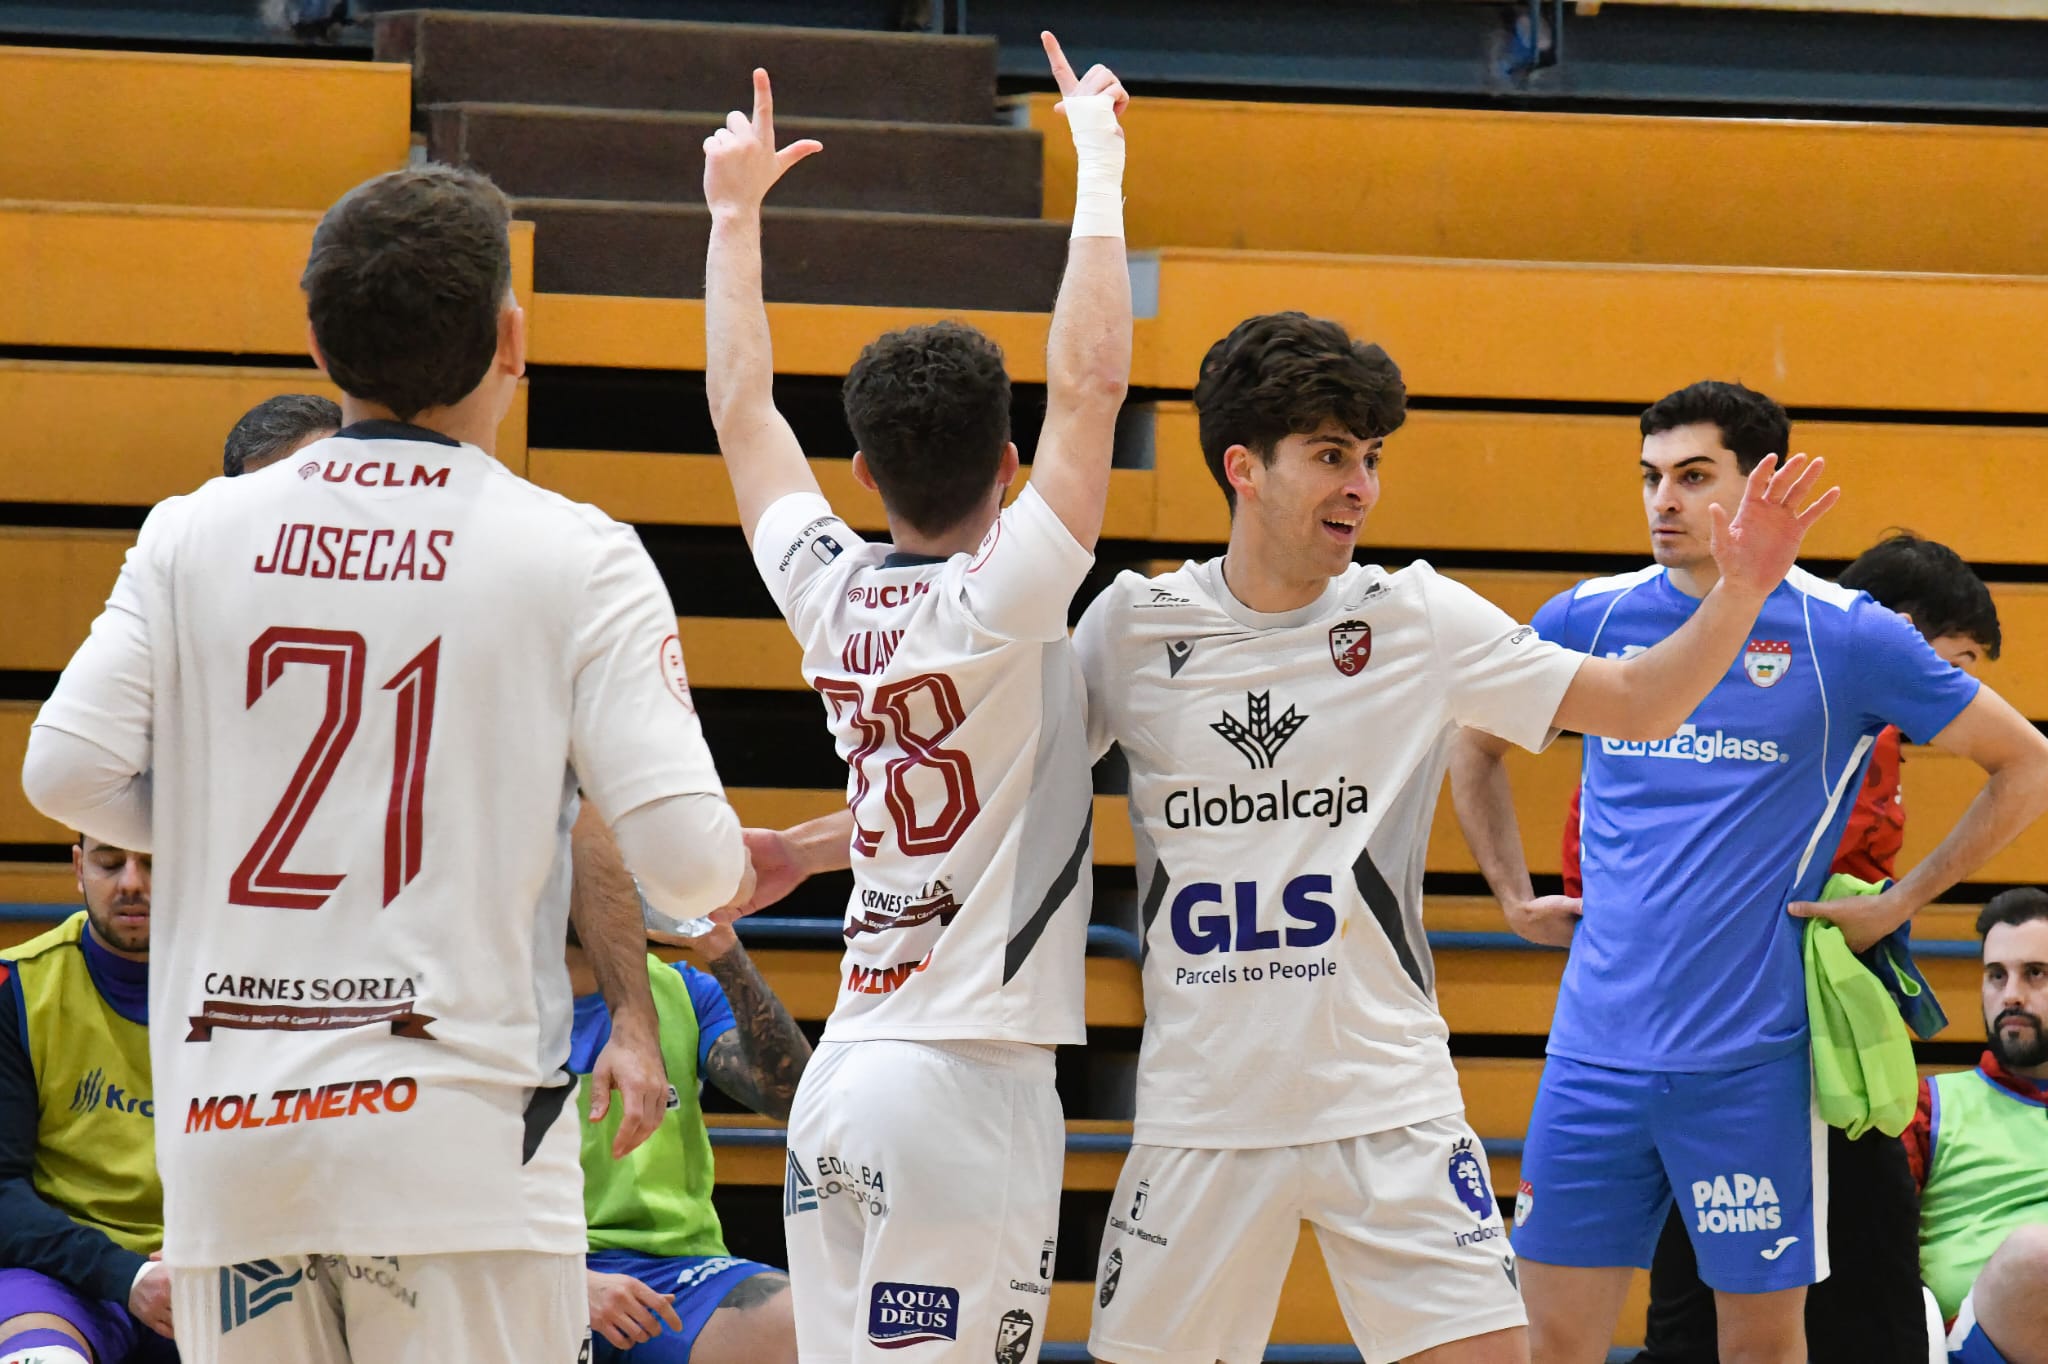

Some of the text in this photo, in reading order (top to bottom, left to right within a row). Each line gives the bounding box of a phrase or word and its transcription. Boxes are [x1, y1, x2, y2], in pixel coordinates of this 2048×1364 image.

[322, 461, 452, 488] UCLM
[254, 523, 454, 581] JOSECAS
[228, 626, 442, 910] 21
[814, 673, 981, 857] 28
[1165, 776, 1369, 830] Globalcaja
[1170, 873, 1337, 956] GLS
[1175, 957, 1338, 985] Parcels to People
[185, 1076, 418, 1134] MOLINERO
[1692, 1173, 1780, 1208] PAPA
[1697, 1206, 1782, 1233] JOHNS
[877, 1289, 953, 1310] AQUA
[879, 1308, 948, 1328] DEUS
